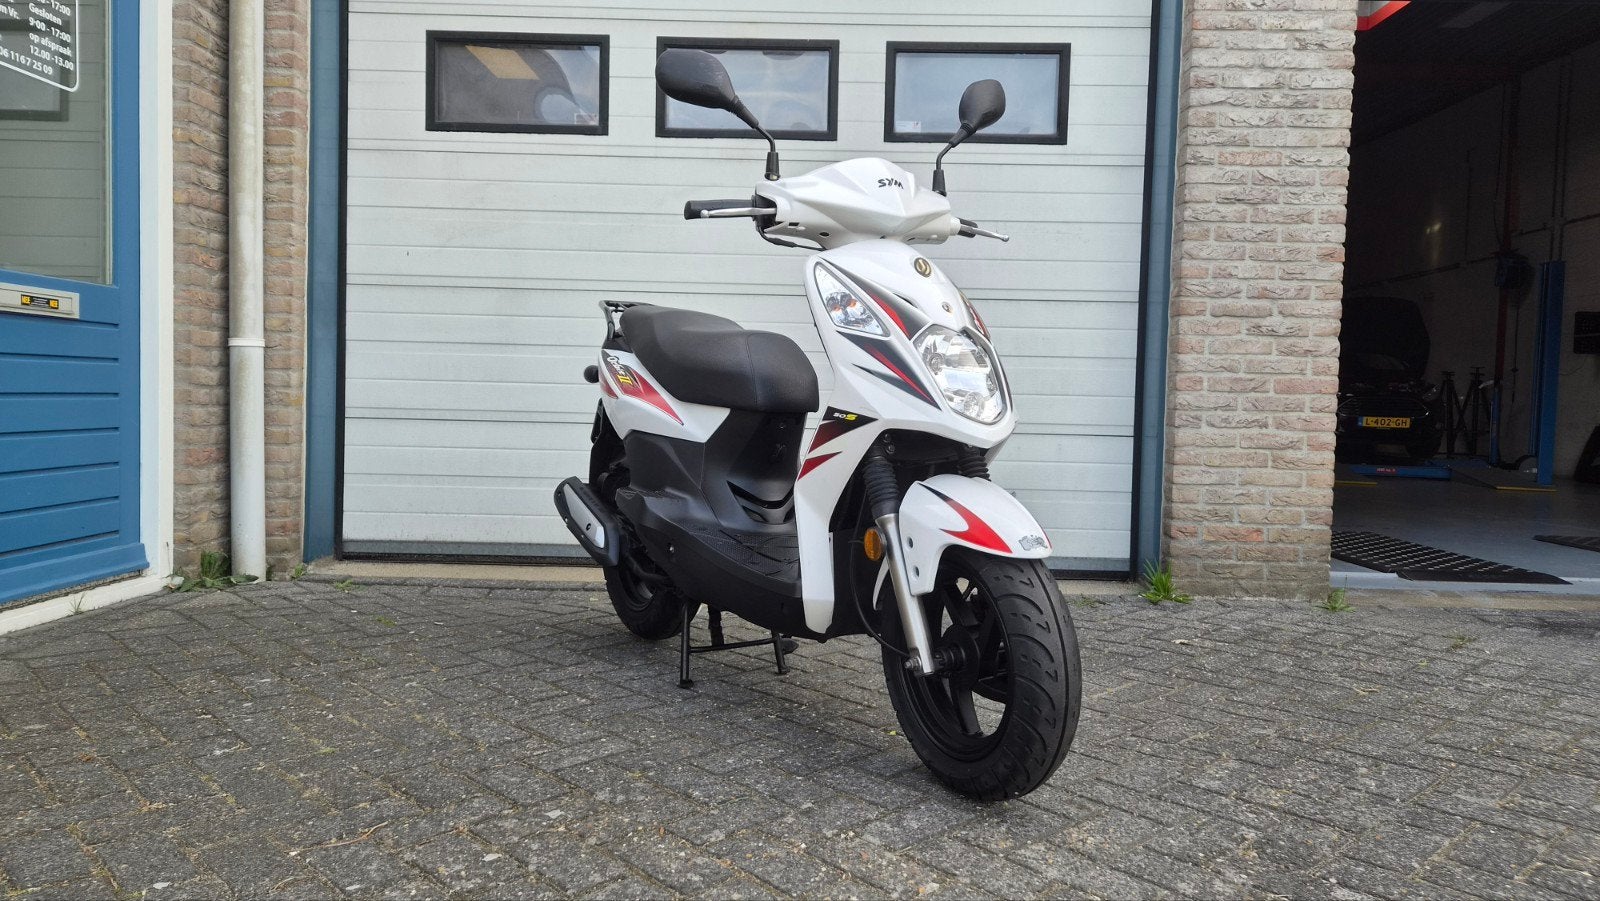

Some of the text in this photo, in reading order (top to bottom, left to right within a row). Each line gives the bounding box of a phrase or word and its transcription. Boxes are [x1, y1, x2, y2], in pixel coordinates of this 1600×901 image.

[8, 6, 20, 19] Vr.
[29, 2, 62, 26] Gesloten
[51, 27, 71, 43] 17:00
[29, 33, 72, 57] op afspraak
[29, 45, 51, 61] 12.00
[877, 177, 904, 189] SYM
